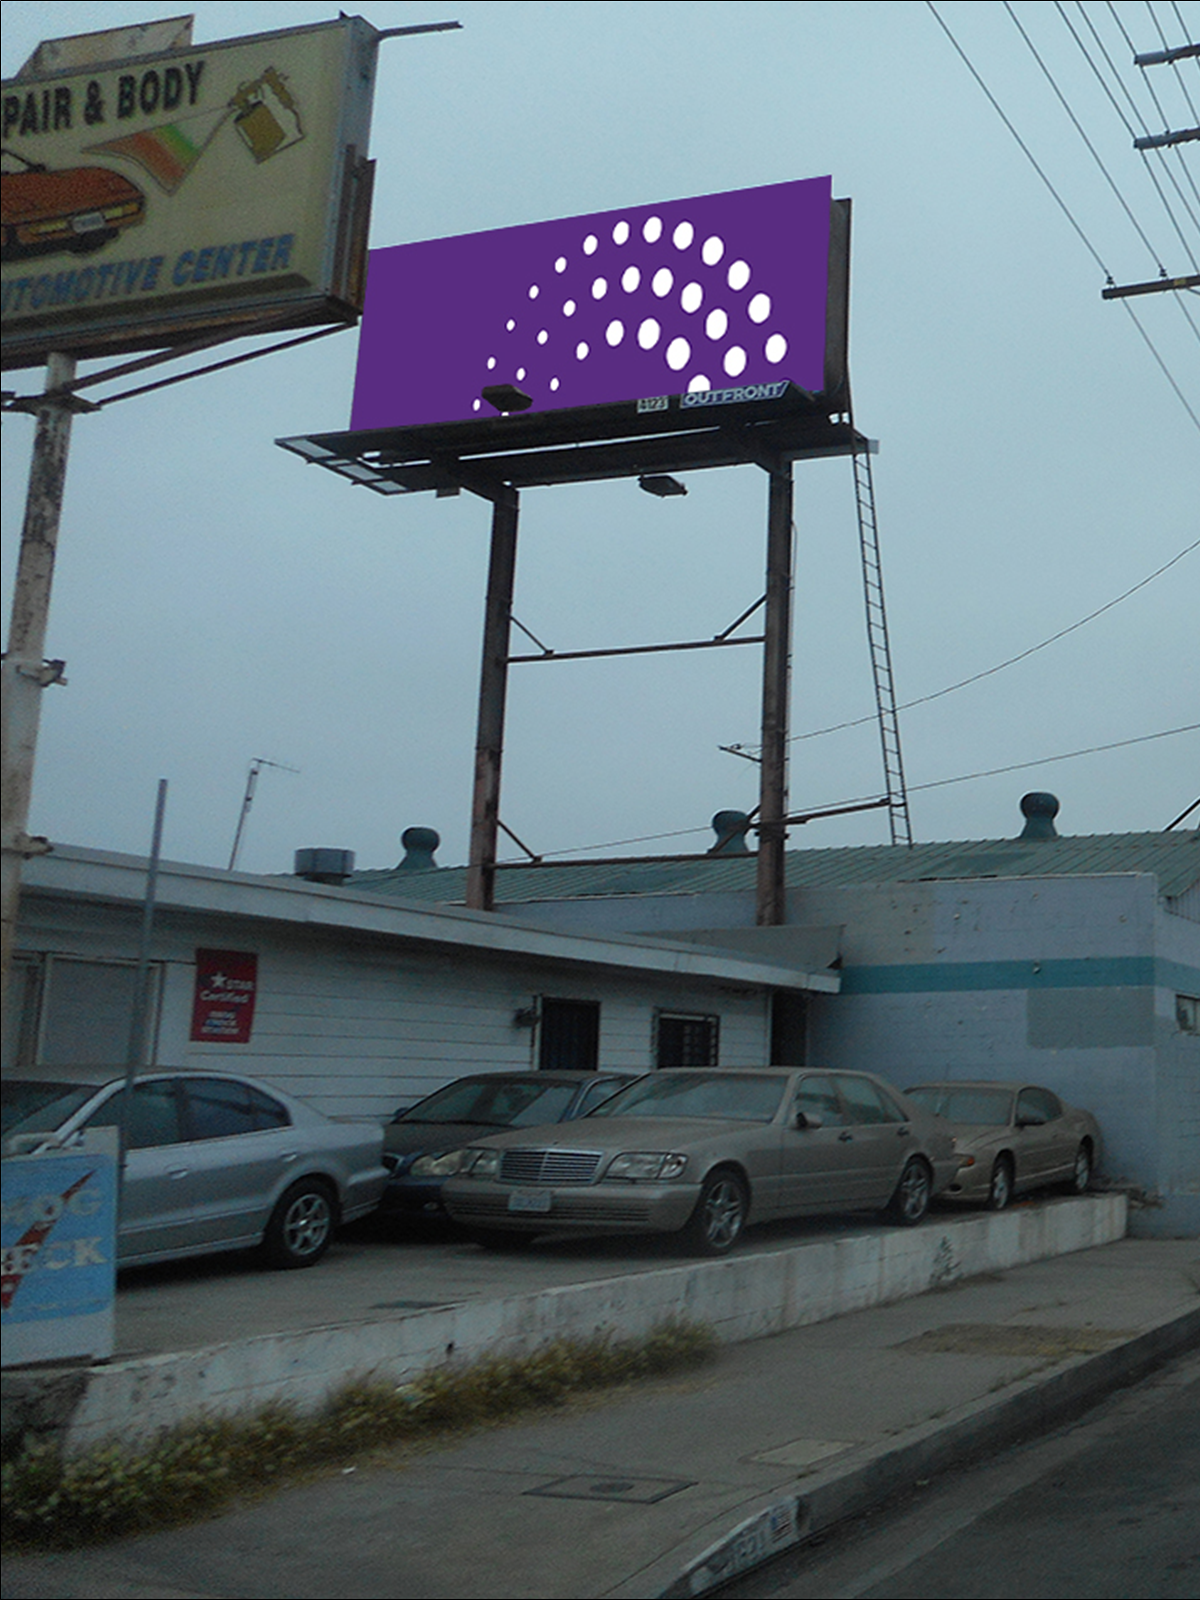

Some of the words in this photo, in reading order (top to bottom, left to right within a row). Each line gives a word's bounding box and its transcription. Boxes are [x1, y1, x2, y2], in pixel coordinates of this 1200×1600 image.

[2, 85, 73, 139] PAIR
[84, 80, 104, 125] &
[117, 60, 205, 119] BODY
[172, 233, 296, 287] CENTER
[684, 381, 784, 405] OUTFRONT
